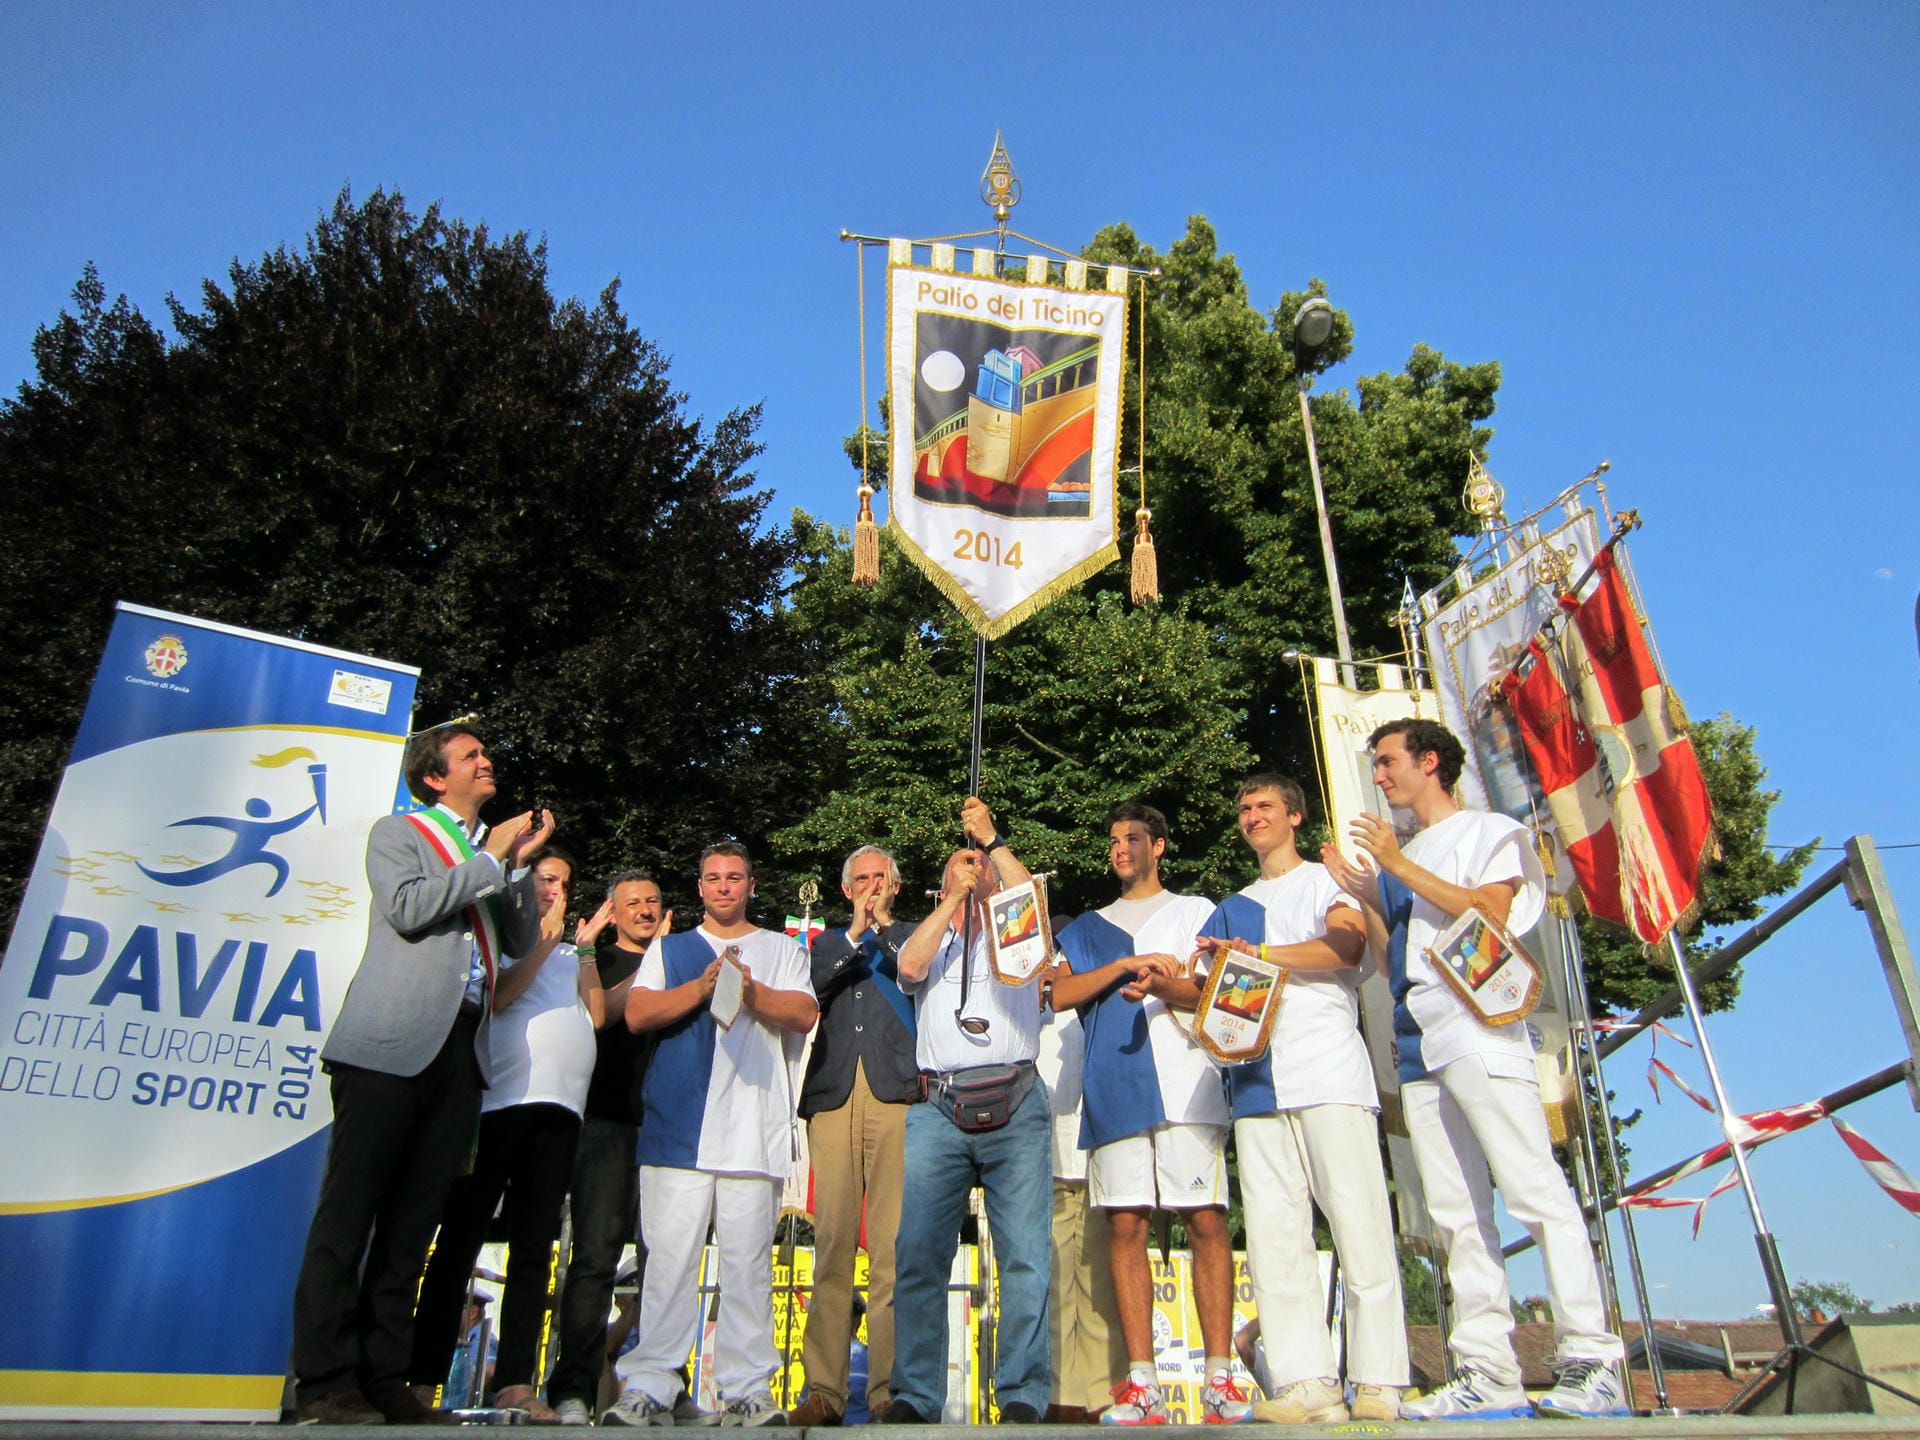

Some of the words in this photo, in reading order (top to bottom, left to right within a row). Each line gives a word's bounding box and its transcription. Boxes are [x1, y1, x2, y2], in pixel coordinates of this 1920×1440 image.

[918, 280, 978, 310] Palio
[987, 294, 1024, 321] del
[1032, 299, 1105, 327] Ticino
[953, 528, 1024, 570] 2014
[1439, 605, 1479, 641] Palio
[1488, 577, 1512, 610] del
[125, 675, 159, 687] Comune
[169, 683, 190, 693] Pavia
[1010, 944, 1032, 957] 2014
[27, 914, 322, 1032] PAVIA
[1489, 968, 1513, 993] 2014
[13, 1011, 106, 1052] CITTÀ
[118, 1022, 273, 1071] EUROPEA
[1221, 1015, 1246, 1032] 2014
[0, 1056, 121, 1101] DELLO
[131, 1071, 267, 1116] SPORT
[272, 1043, 318, 1121] 2014
[1158, 1362, 1181, 1373] NORD
